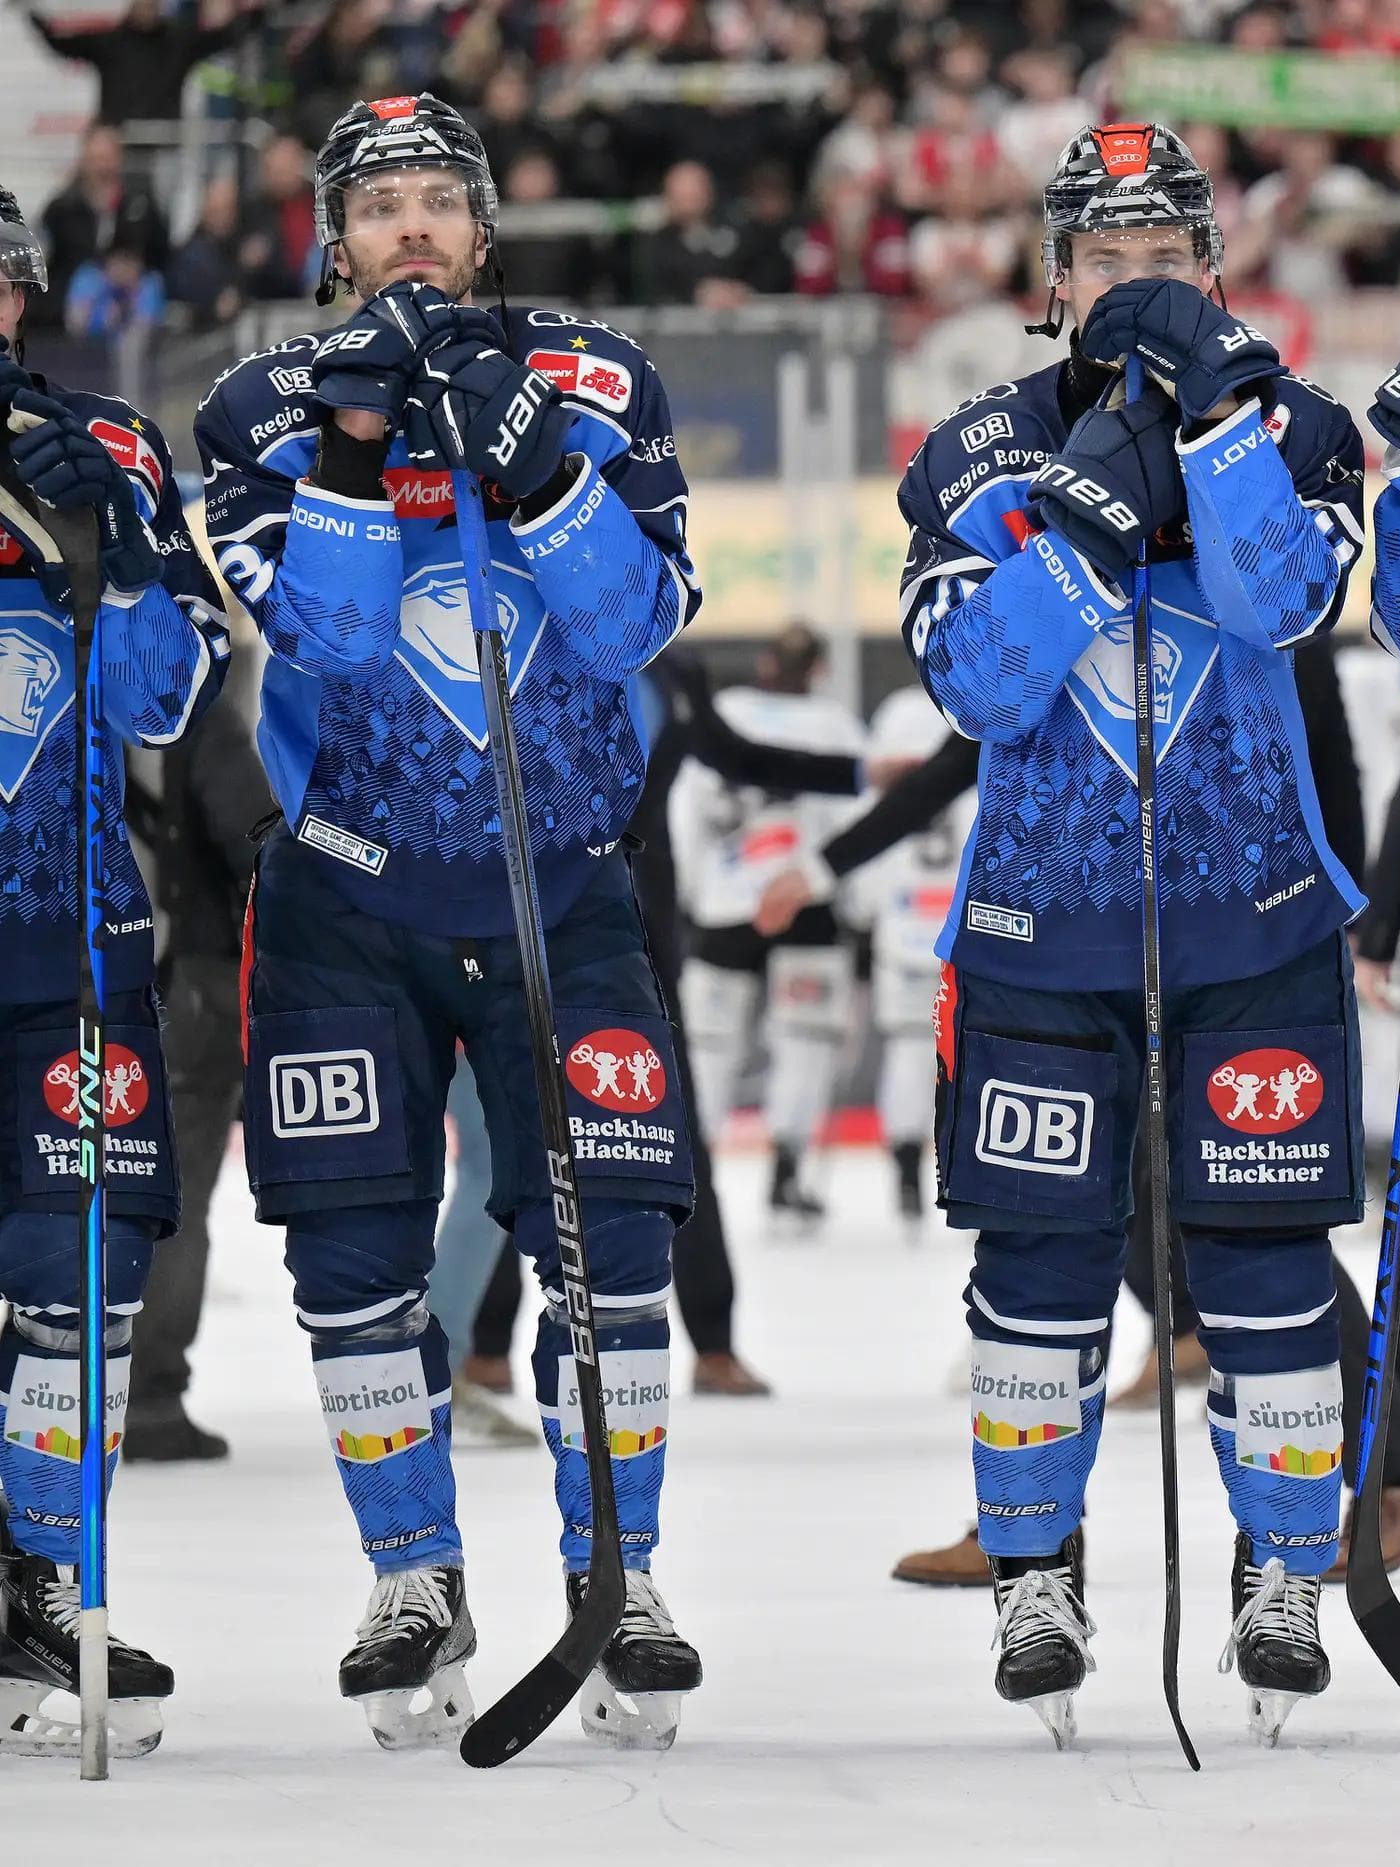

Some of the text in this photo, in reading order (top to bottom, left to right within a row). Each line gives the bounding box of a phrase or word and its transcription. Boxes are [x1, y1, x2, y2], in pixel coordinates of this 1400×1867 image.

[1114, 138, 1138, 147] 90
[1101, 184, 1155, 197] BAUER
[1136, 344, 1177, 371] BAUER
[250, 405, 306, 446] Regio
[488, 371, 552, 467] UER
[966, 416, 1008, 448] DB
[397, 480, 453, 506] Mark
[938, 449, 1053, 511] Regio Bayer
[1035, 461, 1141, 532] BAU
[1137, 663, 1148, 719] NIJENHUIS
[1142, 811, 1153, 881] BAUER
[1264, 878, 1317, 911] BAUER
[79, 1016, 101, 1184] SYNC
[281, 1065, 366, 1124] DB
[567, 1116, 676, 1143] Backhaus
[987, 1096, 1078, 1160] DB
[34, 1132, 159, 1156] Bachaus
[573, 1139, 675, 1165] Hackner
[1200, 1140, 1331, 1162] Backhaus
[46, 1154, 157, 1178] Hakner
[1207, 1163, 1325, 1185] Hackner
[547, 1149, 597, 1367] BAUER
[979, 1502, 1059, 1518] BAUER
[370, 1524, 438, 1552] BAUER
[1287, 1529, 1341, 1549] BAUE
[23, 1634, 74, 1678] BAUER
